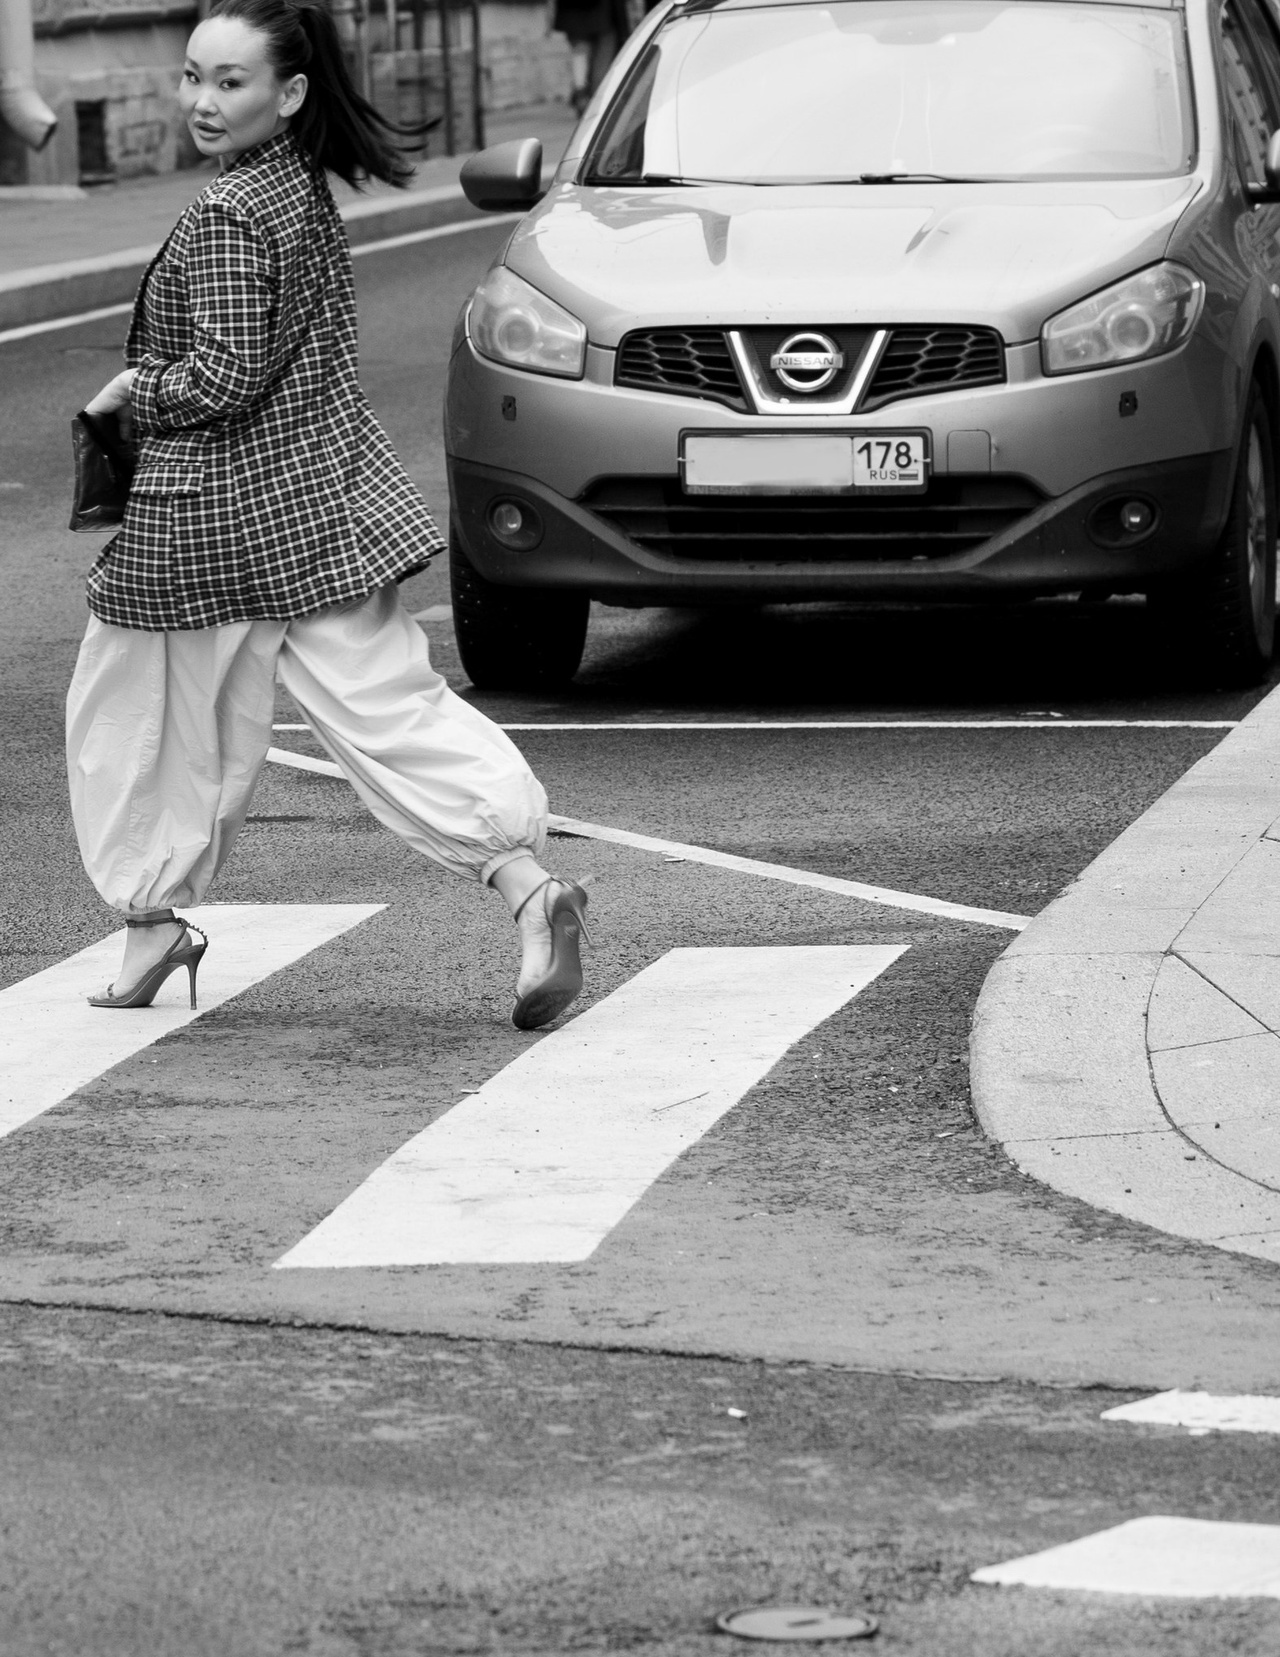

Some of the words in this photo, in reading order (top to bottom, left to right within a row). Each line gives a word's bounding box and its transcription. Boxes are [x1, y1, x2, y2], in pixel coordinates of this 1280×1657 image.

[778, 356, 834, 365] NISSAN
[857, 441, 912, 469] 178
[869, 470, 897, 480] RUS
